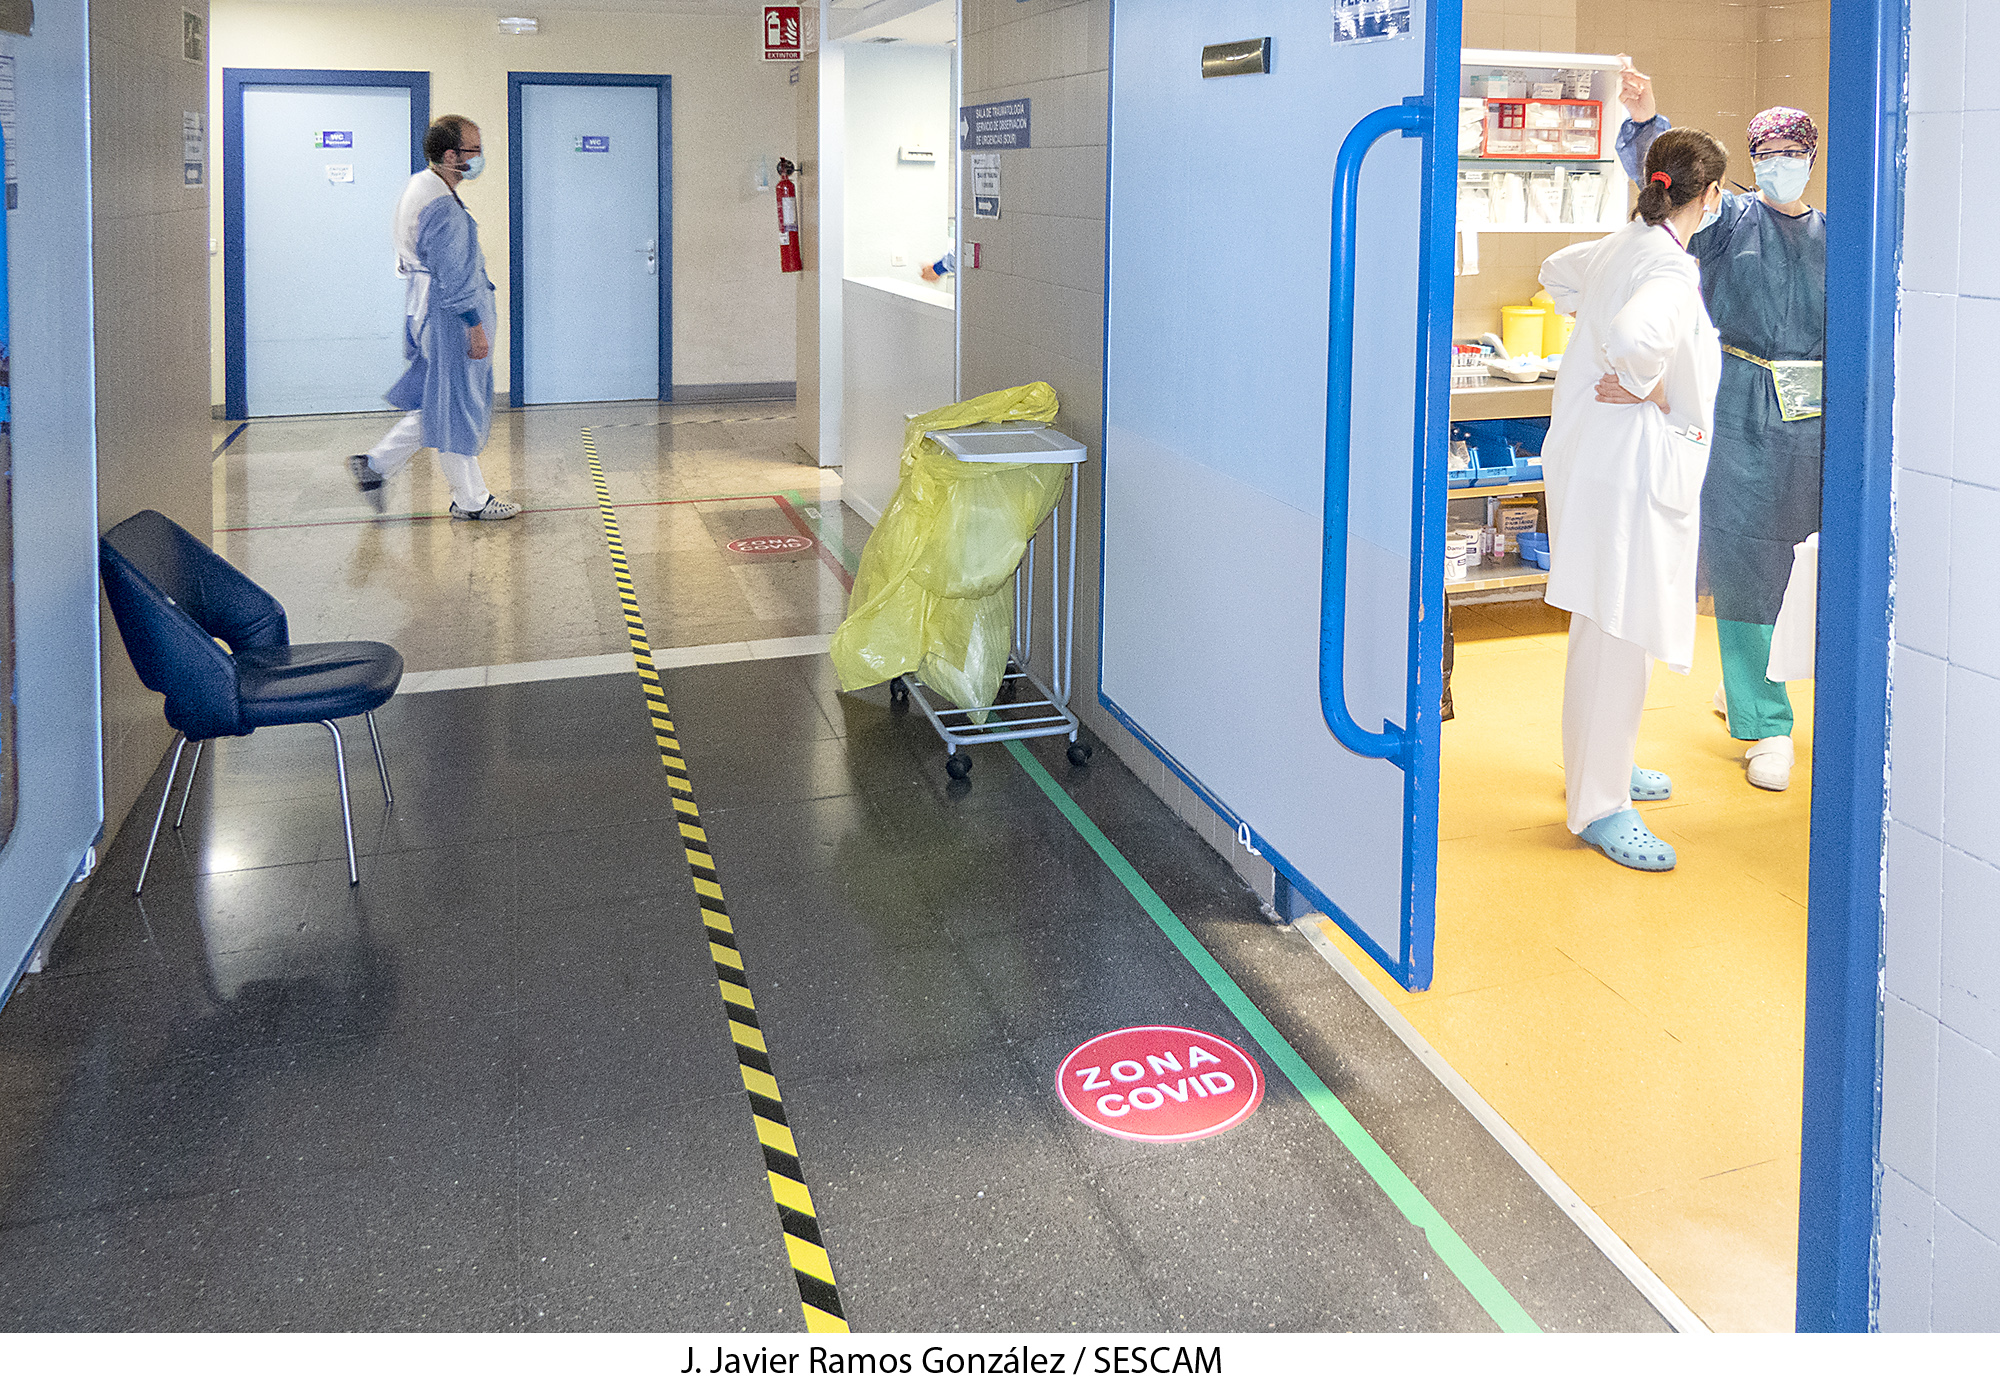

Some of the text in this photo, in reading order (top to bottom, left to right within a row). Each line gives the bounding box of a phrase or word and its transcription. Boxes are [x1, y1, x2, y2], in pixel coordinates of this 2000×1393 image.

[976, 102, 1025, 119] SALA DE TRAUMATOLOGÍA
[976, 117, 1027, 132] SERVICIO DE OBSERVACIÓN
[330, 133, 344, 141] WC
[976, 135, 982, 146] DE
[982, 134, 1003, 146] URGENCIAS
[1075, 1045, 1221, 1092] ZONA
[1096, 1071, 1235, 1117] COVID
